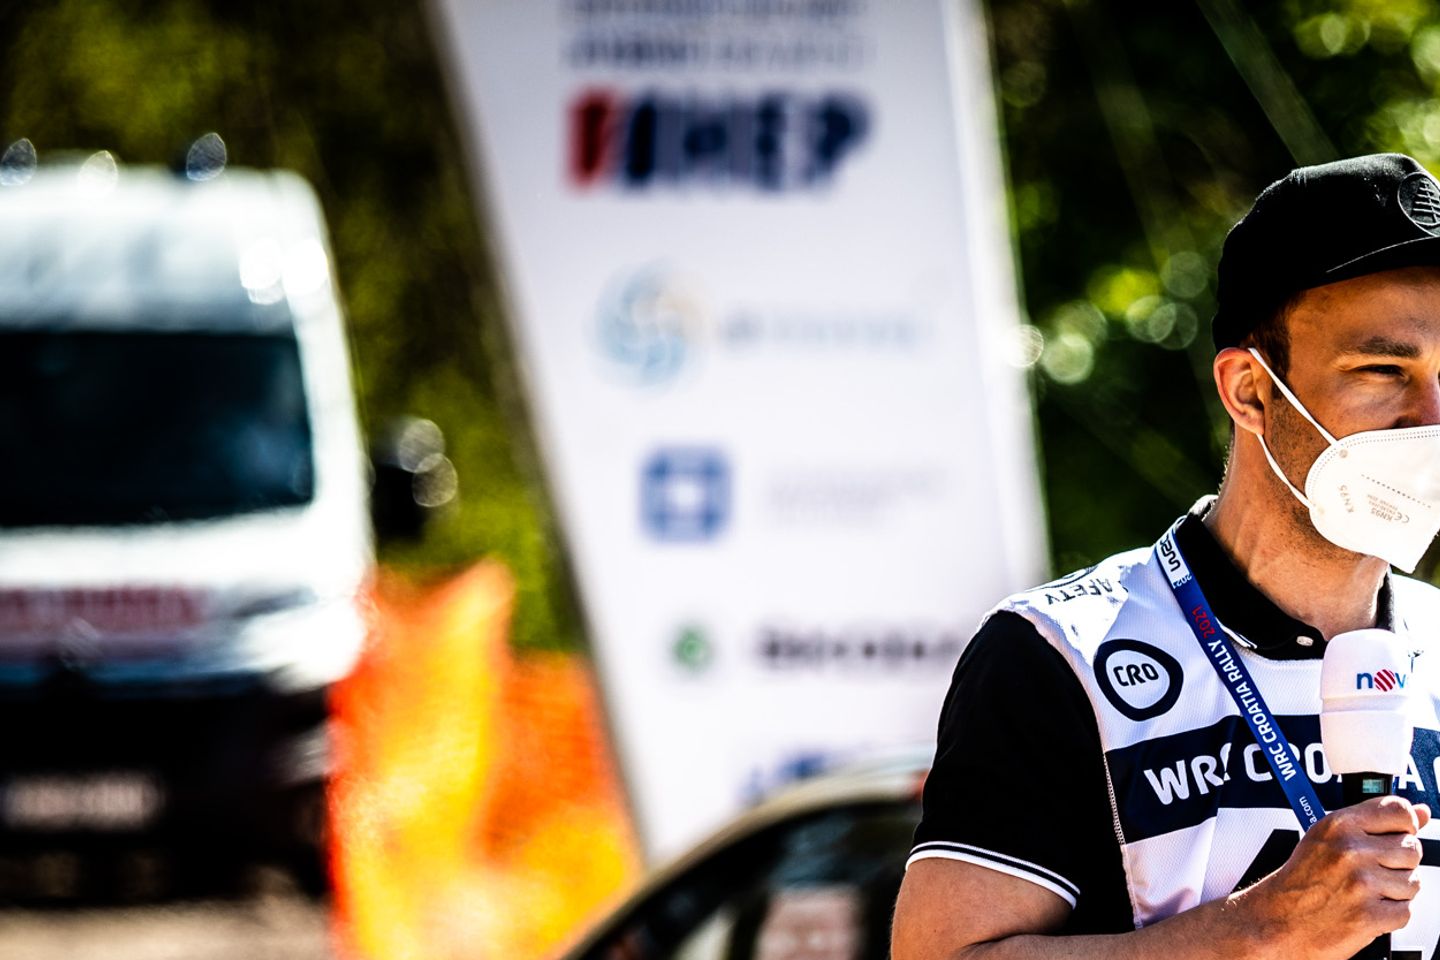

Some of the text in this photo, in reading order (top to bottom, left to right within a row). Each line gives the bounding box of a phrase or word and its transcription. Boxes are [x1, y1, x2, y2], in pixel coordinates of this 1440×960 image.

[1046, 577, 1127, 605] AFETY
[1113, 663, 1159, 688] CRO
[1356, 668, 1407, 692] nov
[1192, 604, 1297, 781] WRC CROATIA RALLY 2021
